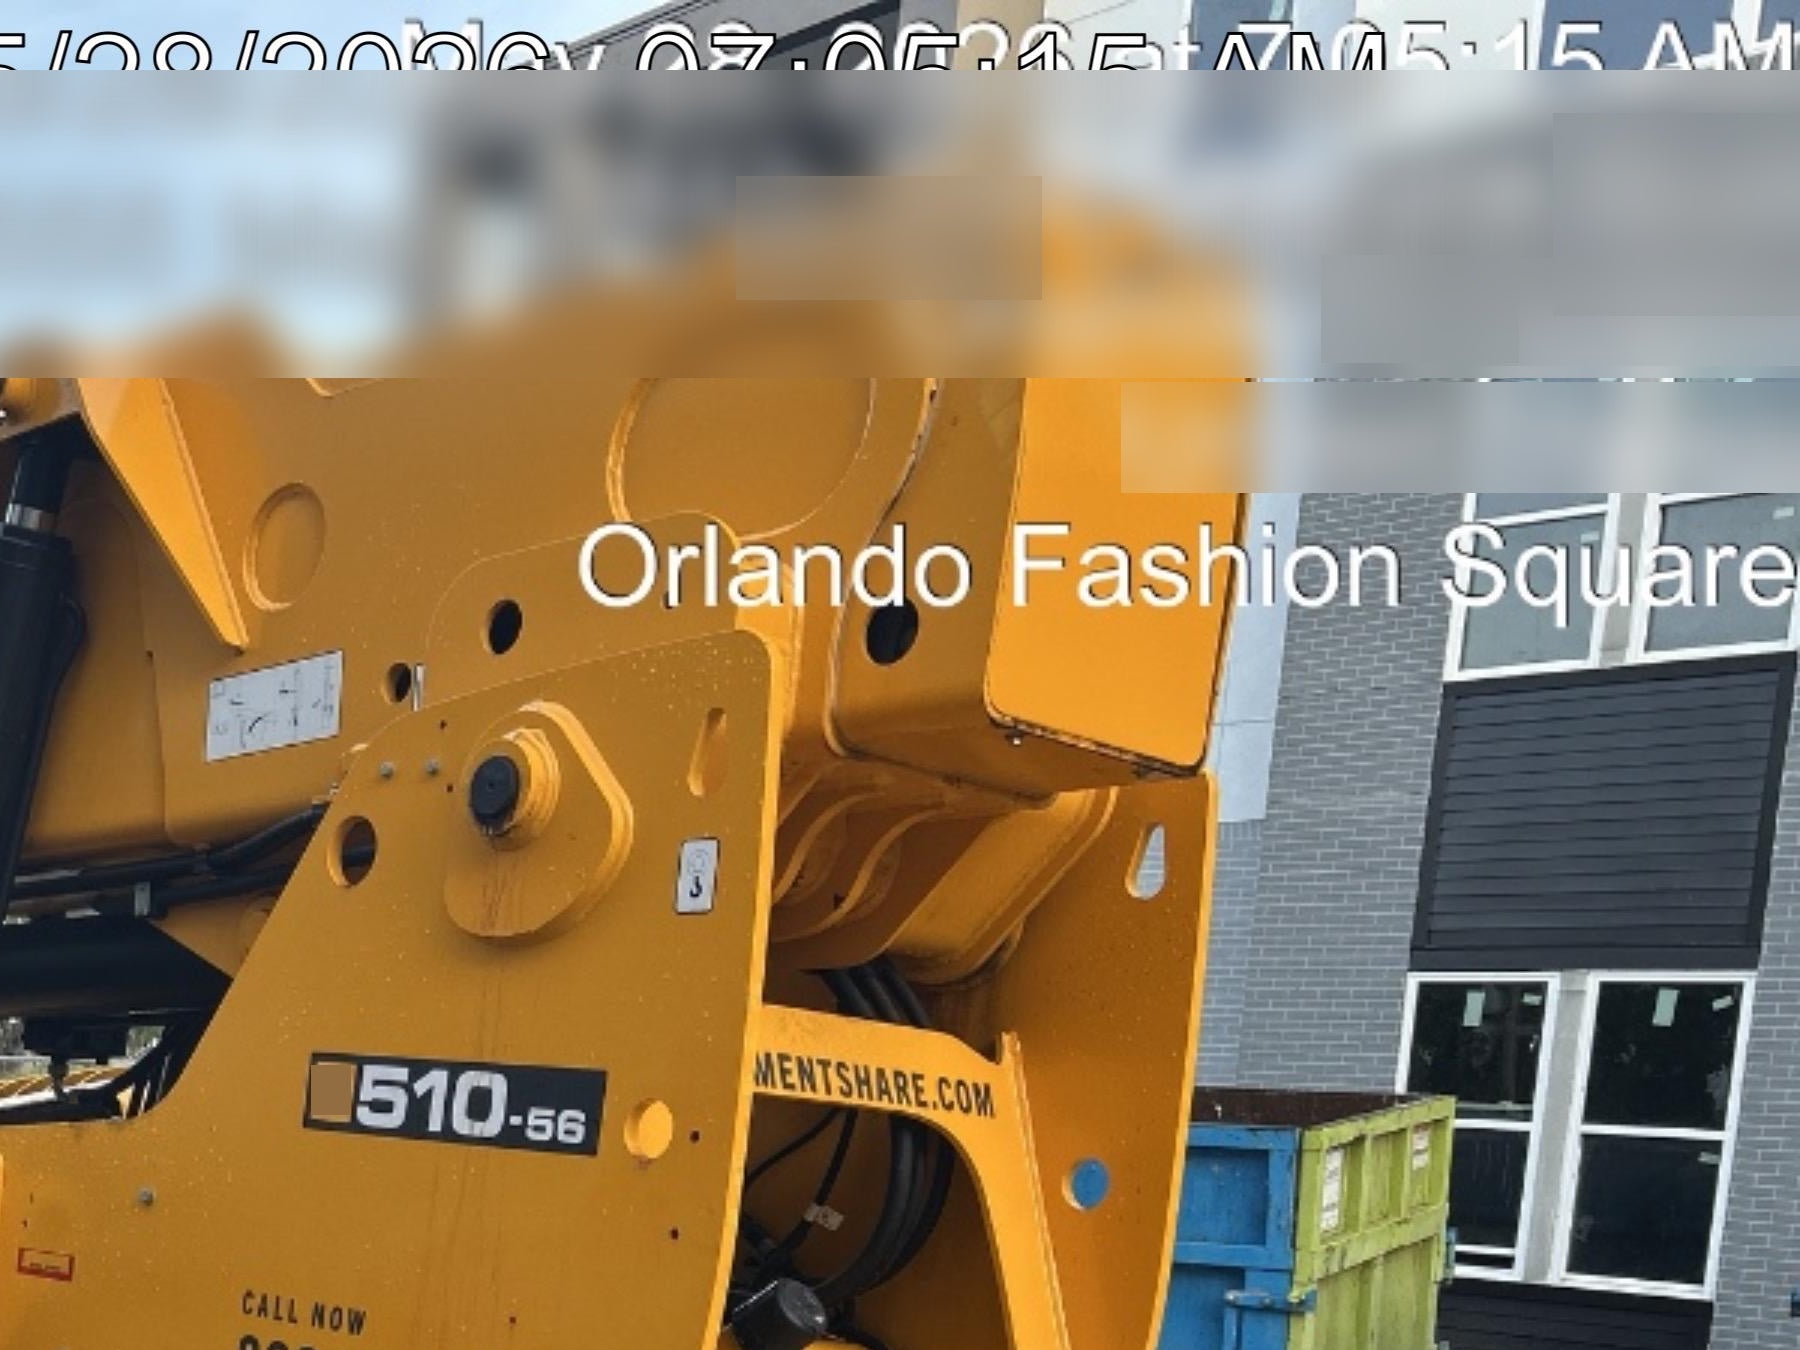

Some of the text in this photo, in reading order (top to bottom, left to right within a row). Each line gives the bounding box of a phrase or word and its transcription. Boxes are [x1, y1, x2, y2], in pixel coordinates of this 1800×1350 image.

[356, 1063, 586, 1144] 510-56
[242, 1290, 367, 1335] CALL NOW
